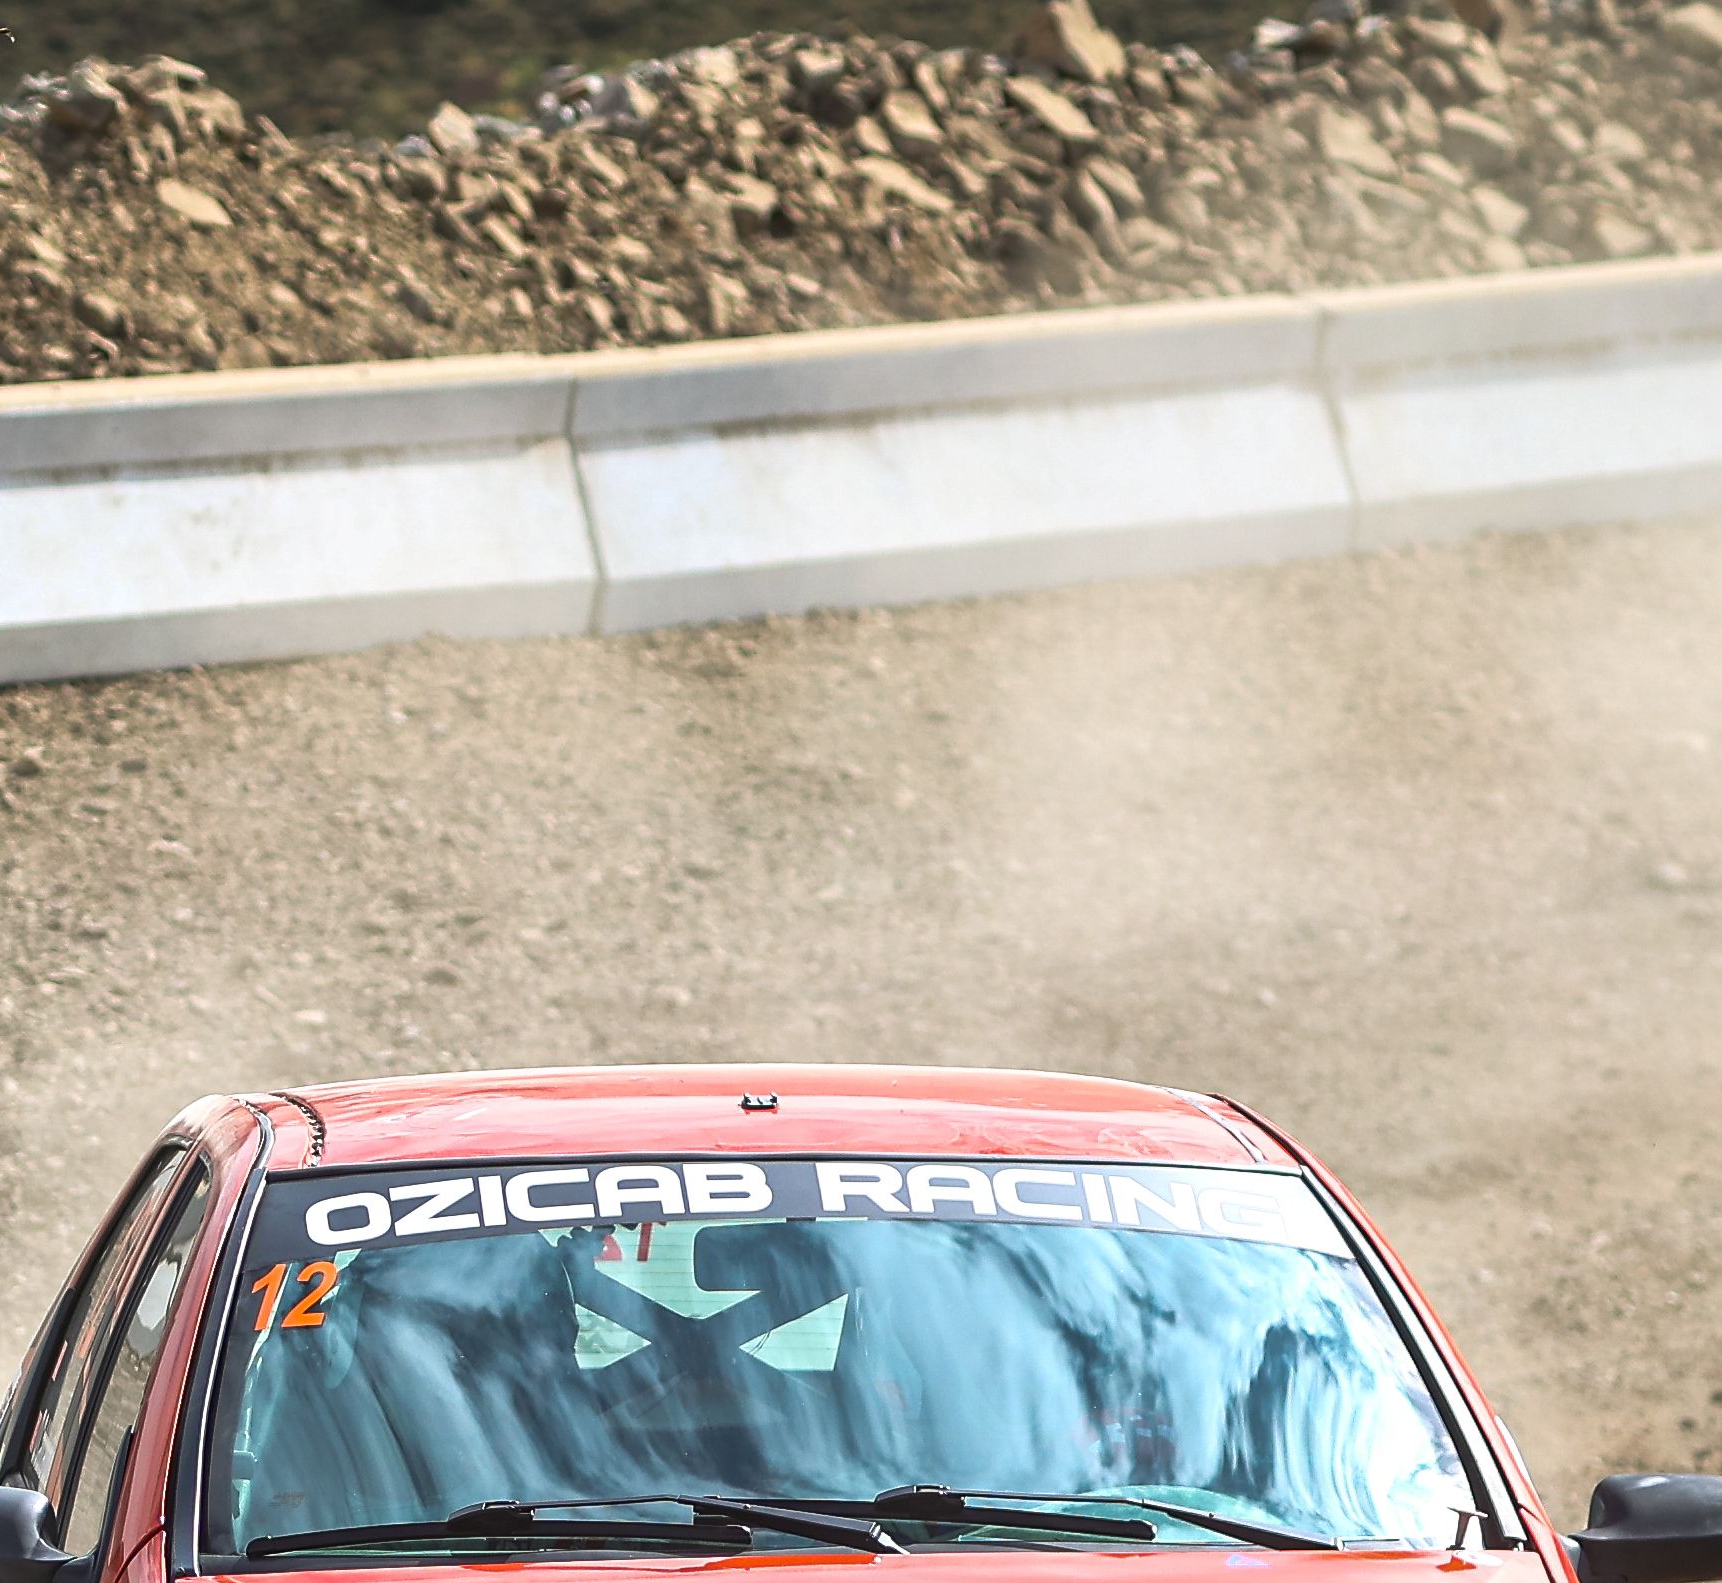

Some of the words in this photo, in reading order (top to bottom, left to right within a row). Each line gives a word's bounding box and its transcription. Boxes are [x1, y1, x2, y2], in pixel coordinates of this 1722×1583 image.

[305, 1162, 774, 1247] OZICAB
[815, 1162, 1289, 1243] RACING
[250, 1261, 340, 1332] 12
